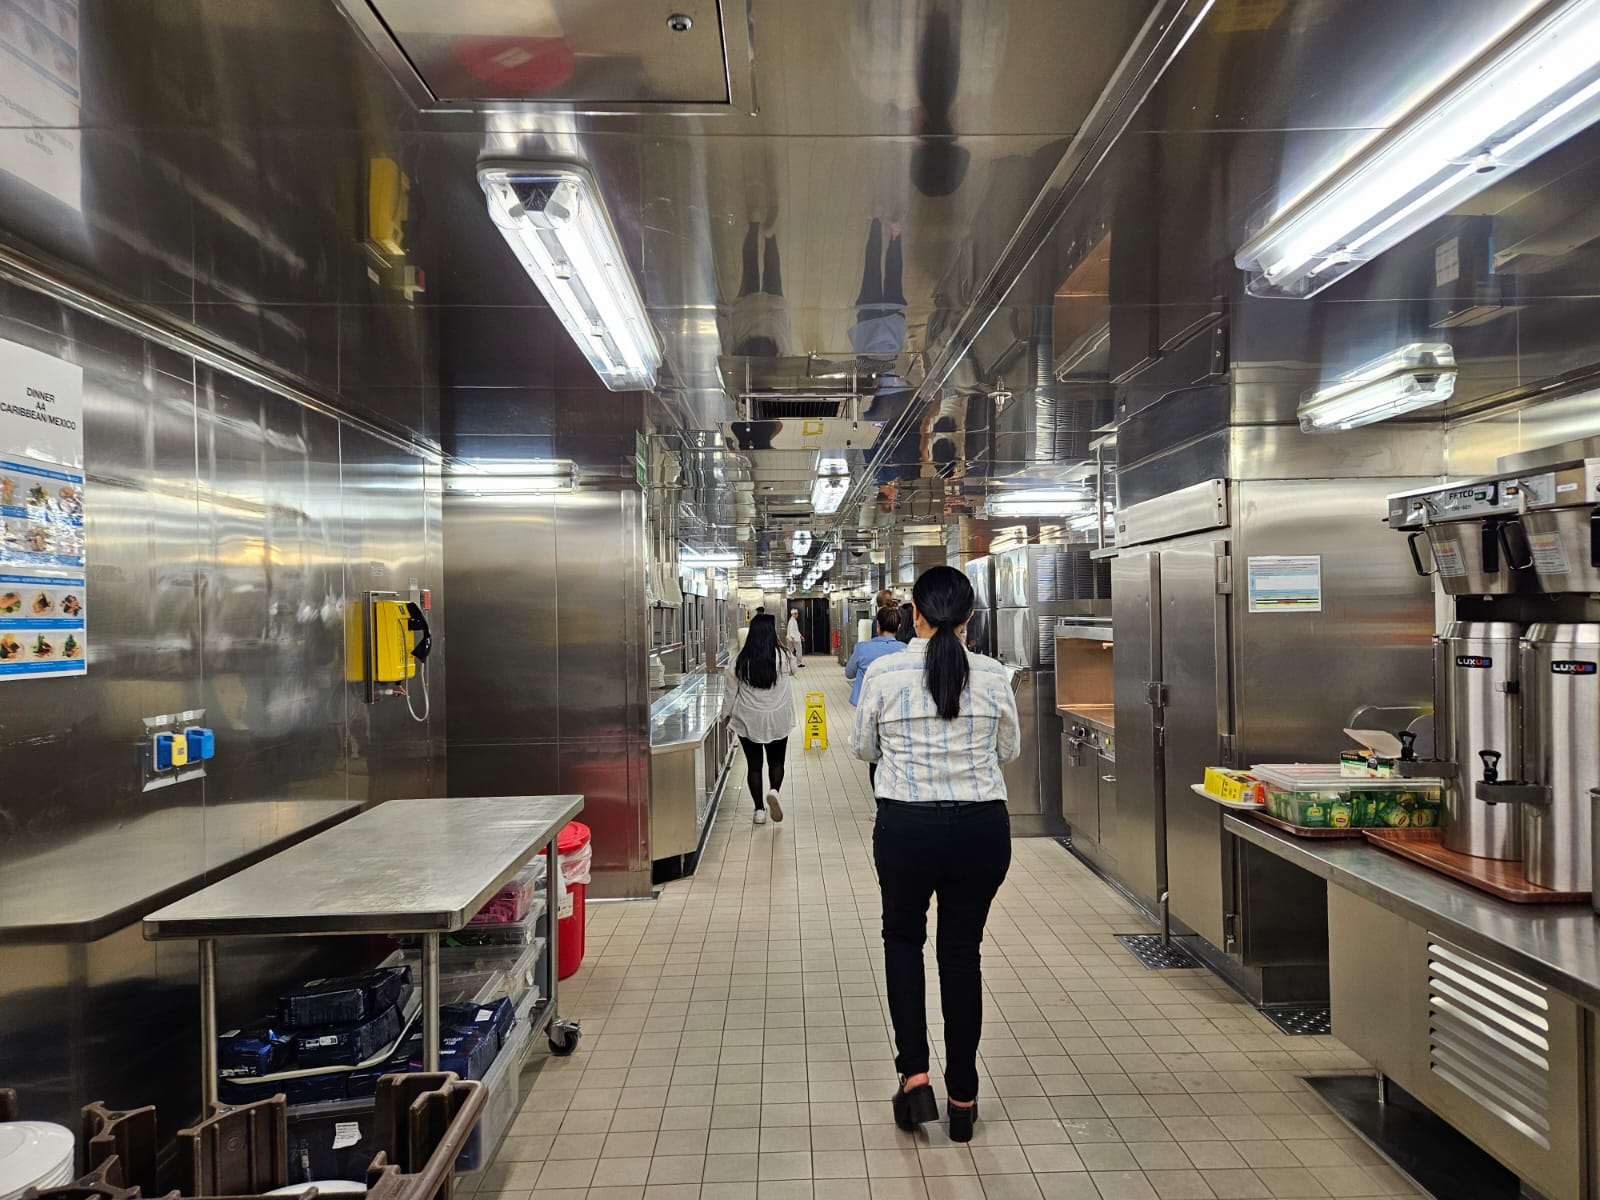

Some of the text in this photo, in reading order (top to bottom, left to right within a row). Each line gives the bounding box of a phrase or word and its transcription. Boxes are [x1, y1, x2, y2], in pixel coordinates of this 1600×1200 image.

[26, 387, 55, 404] DINNER
[36, 401, 46, 411] AA
[0, 402, 76, 430] CARIBBEAN/MEXICO
